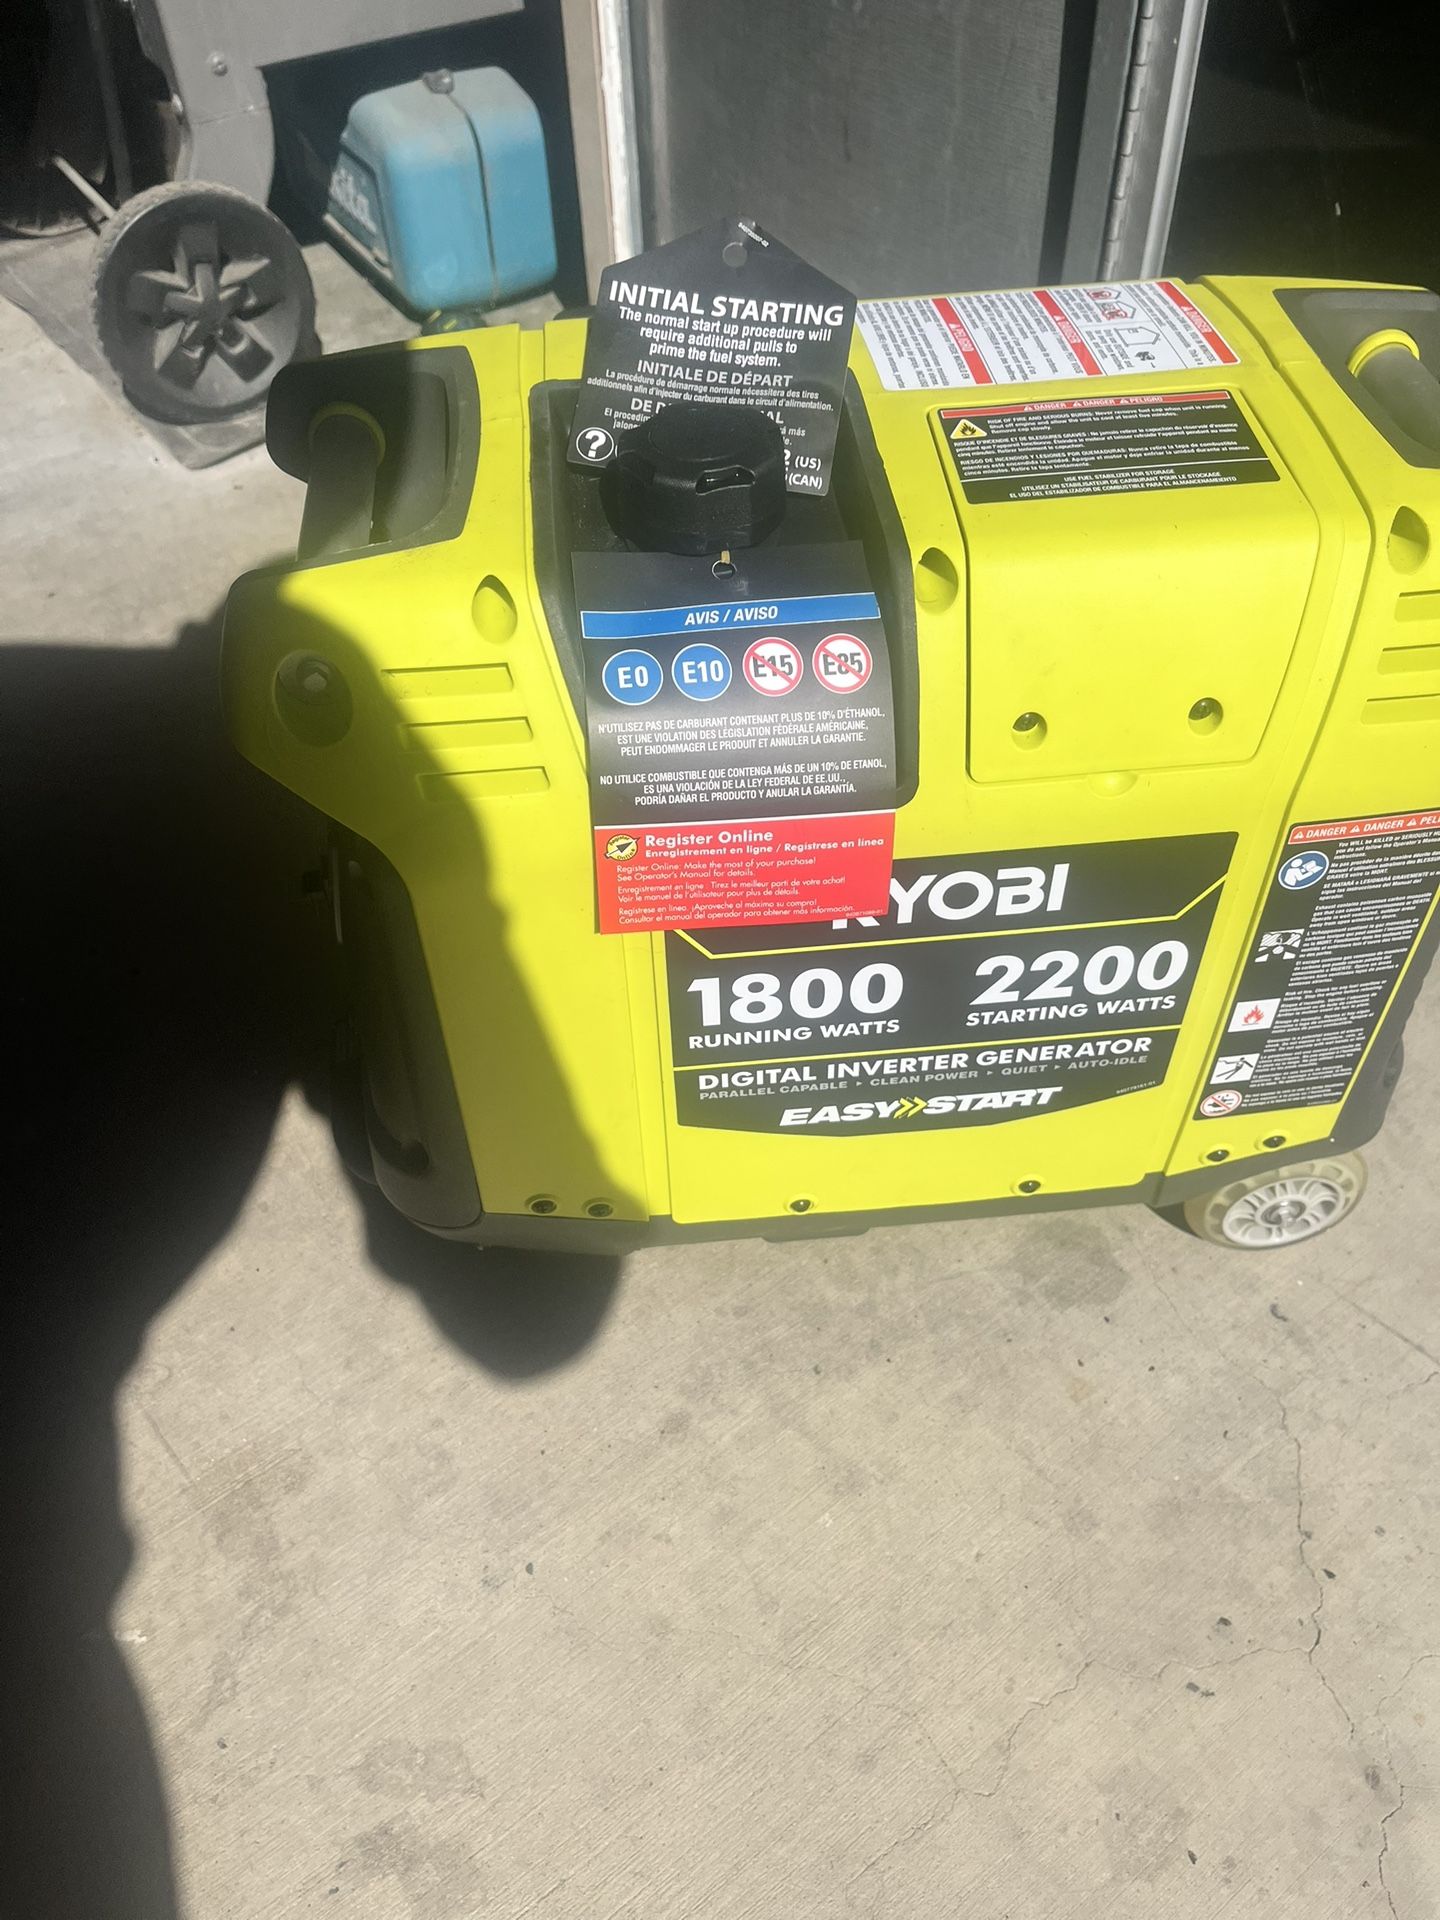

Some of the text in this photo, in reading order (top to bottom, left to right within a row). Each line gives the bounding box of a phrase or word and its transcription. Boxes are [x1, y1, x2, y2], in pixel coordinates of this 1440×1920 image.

[609, 281, 843, 326] INITIAL STARTING
[619, 305, 832, 342] The normal start up procedure will
[639, 326, 798, 354] require additional pulls to
[649, 342, 781, 368] prime the fuel system.
[605, 368, 820, 400] La procédure de démarrage normale nécessitera des tires
[637, 360, 793, 387] INITIALE DE DÉPART
[587, 377, 834, 411] additionnels afin d'injecter du carburant dans le circuit d'alimentation.
[631, 398, 652, 413] DE
[1033, 402, 1067, 410] DANGER
[1129, 395, 1163, 403] PELIGRO
[604, 407, 613, 417] El
[788, 428, 806, 437] más
[795, 455, 821, 471] (US)
[788, 473, 823, 489] (CAN)
[684, 605, 779, 626] AVIS / AVISO
[618, 652, 864, 689] E0 E10 E15 E85
[597, 707, 885, 734] N'UTILISEZ PAS DE CARBURANT CONTENANT PLUS DE 10% D'ÉTHANOL,
[615, 719, 869, 745] EST UNE VIOLATION DES LÉGISLATION FÉDÉRALE AMÉRICAINE,
[620, 731, 866, 757] PEUT ENDOMMAGER LE PRODUIT ET ANNULER LA GARANTIE.
[599, 758, 887, 785] NO UTILICE COMBUSTIBLE QUE CONTENGA MÁS DE UN 10% DE ETANOL,
[643, 784, 655, 795] ES
[655, 783, 675, 795] UNA
[675, 779, 721, 792] VIOLACIÓN
[721, 779, 734, 790] DE
[734, 778, 747, 789] LA
[746, 777, 763, 788] LEY
[764, 775, 801, 787] FEDERAL
[802, 774, 814, 785] DE
[634, 781, 857, 806] PODRÍA DAÑAR EL PRODUCTO Y ANULAR LA GARANTÍA.
[645, 833, 713, 849] Register
[718, 829, 773, 844] Online
[1306, 827, 1346, 838] DANGER
[1363, 820, 1404, 832] DANGER
[645, 847, 727, 858] Enregistrement
[729, 847, 744, 855] en
[746, 845, 773, 855] ligne
[841, 840, 855, 848] en
[616, 864, 649, 875] Register
[683, 860, 707, 870] Make
[709, 860, 723, 869] the
[723, 861, 744, 869] most
[744, 858, 755, 870] of
[755, 860, 775, 869] your
[776, 856, 816, 868] purchase!
[831, 863, 1070, 930] YOBI
[686, 939, 1189, 1027] 1800 2200
[966, 995, 1176, 1026] STARTING WATTS
[689, 1019, 900, 1049] RUNNING WATTS
[699, 1037, 1151, 1090] DIGITAL INVERTER GENERATOR
[699, 1055, 1147, 1100] PARALLEL CAPABLE CLEAN POWER QUIET AUTO-IDLE
[779, 1085, 1064, 1127] EASY START
